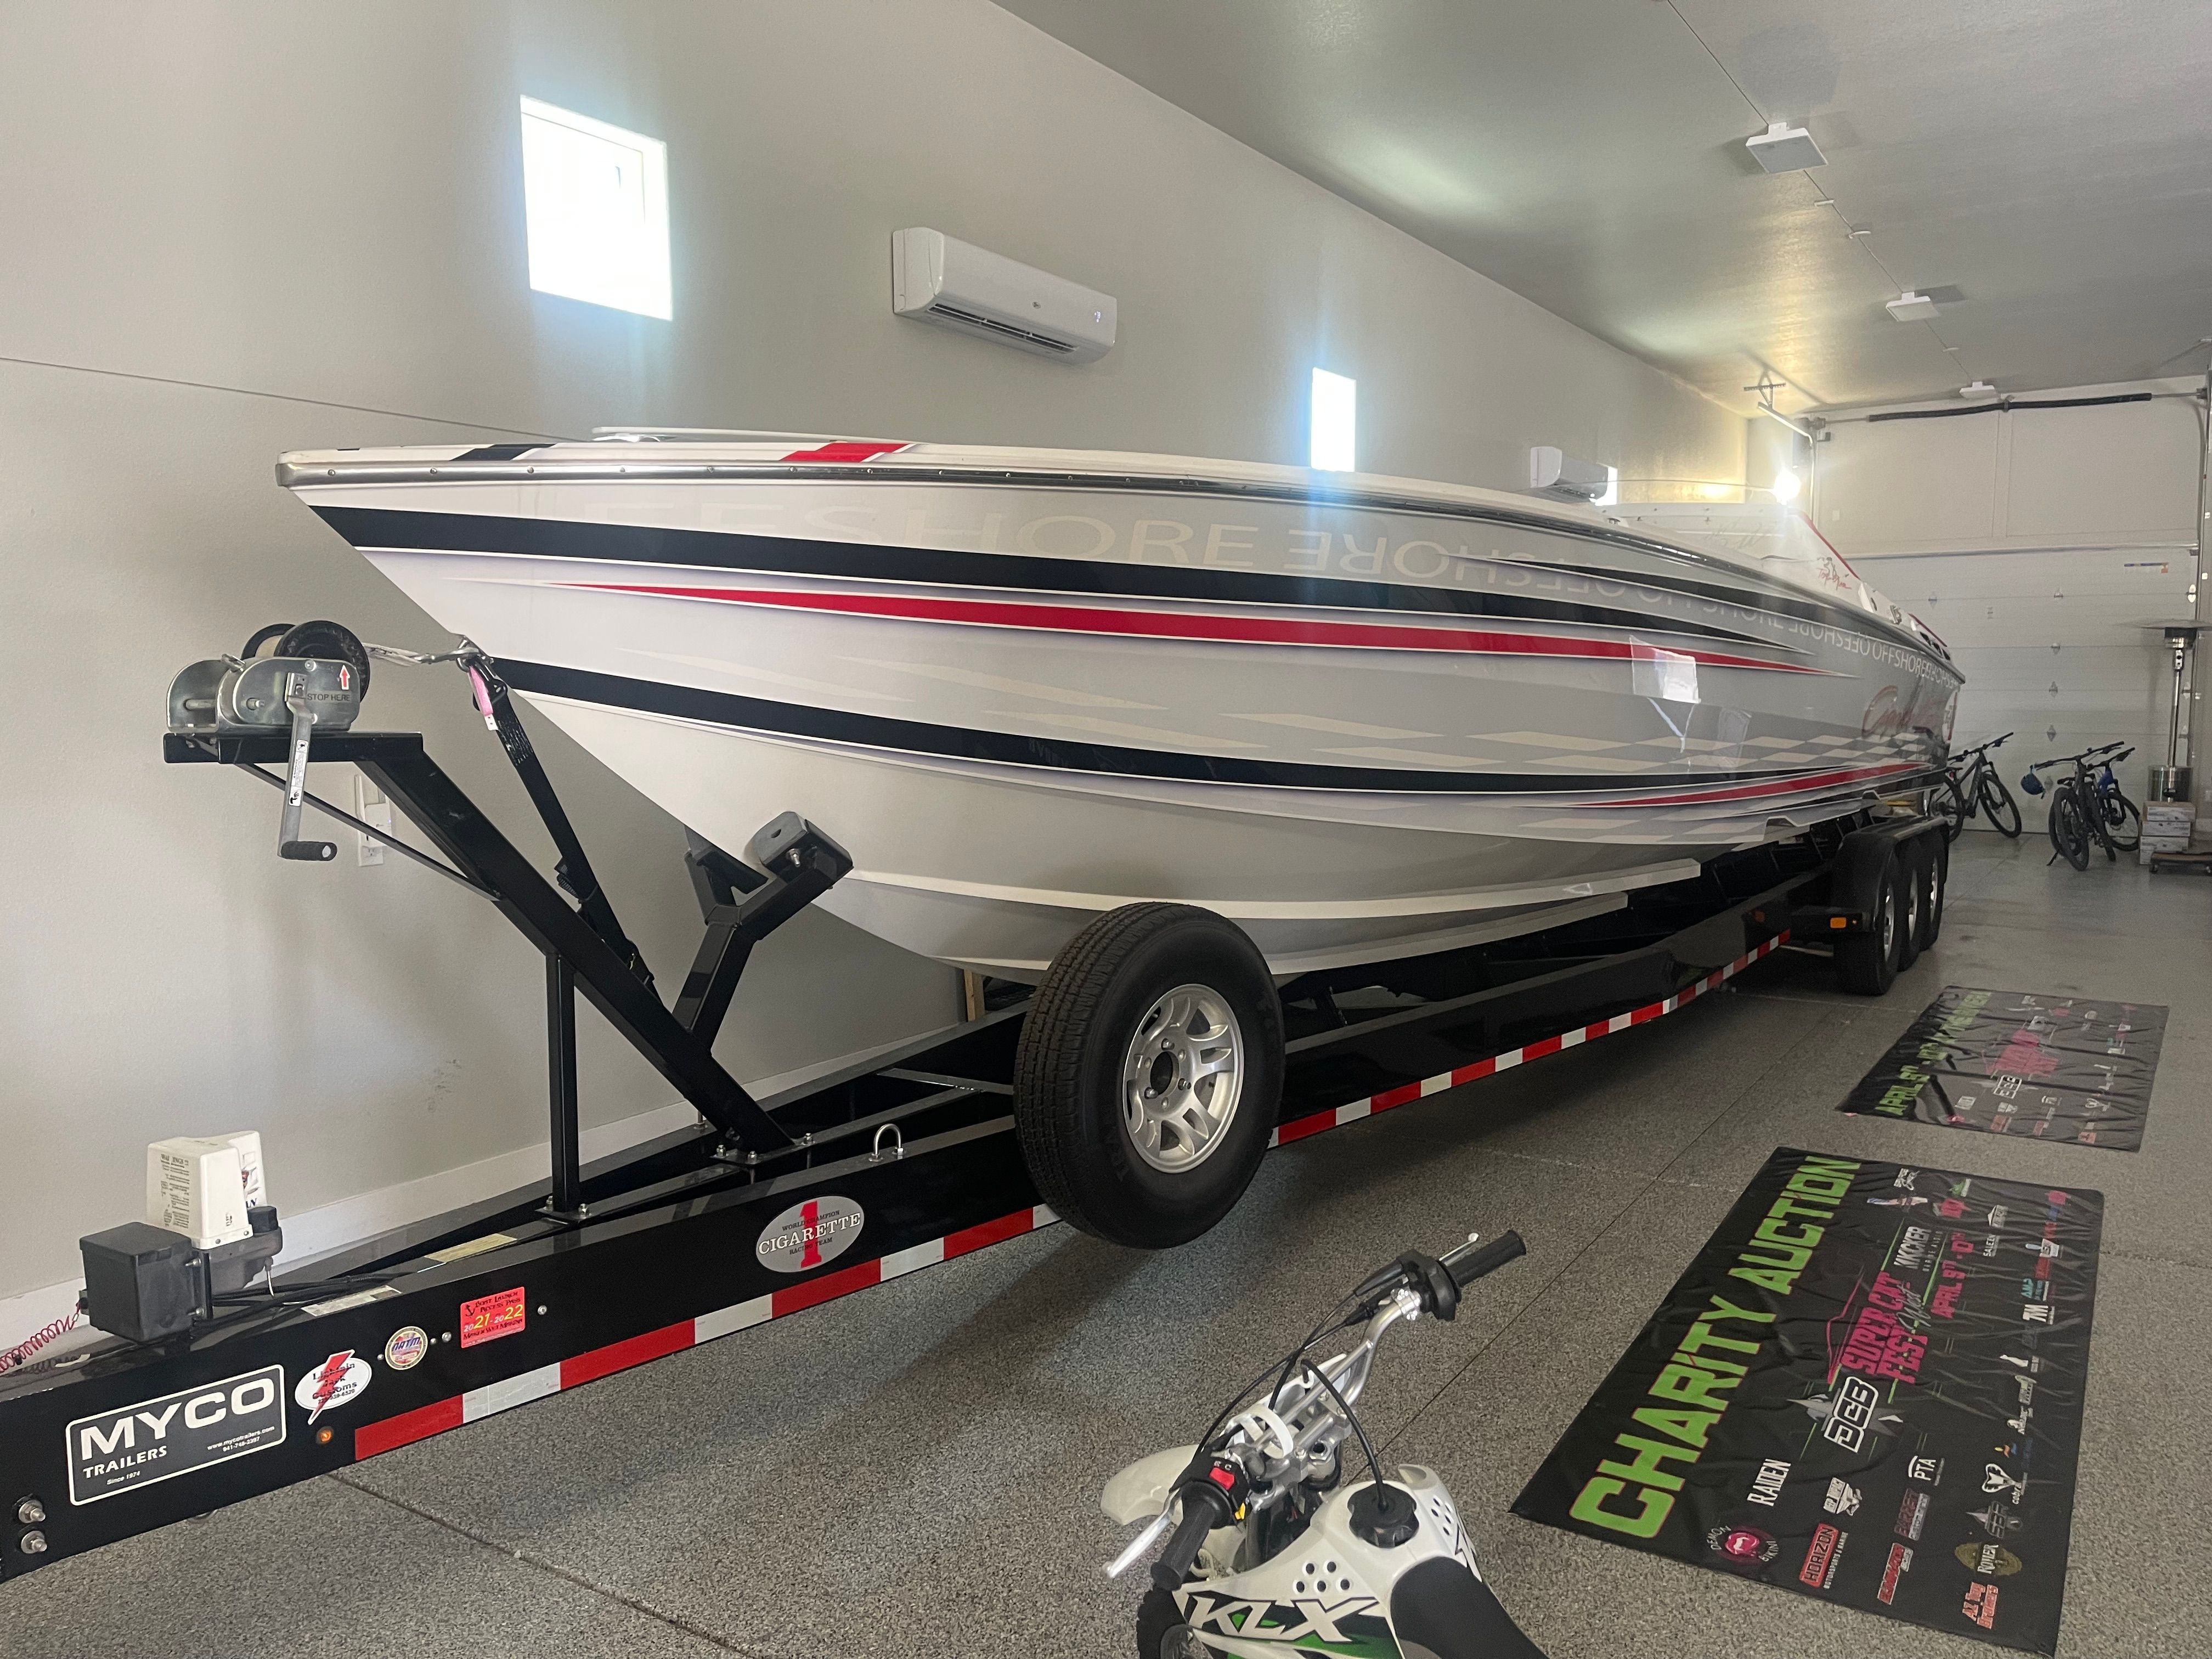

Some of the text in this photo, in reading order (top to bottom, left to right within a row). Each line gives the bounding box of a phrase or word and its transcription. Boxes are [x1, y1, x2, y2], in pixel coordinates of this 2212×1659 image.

[759, 1212, 861, 1255] CIGARETTE
[782, 1210, 839, 1232] WORLD CHAMPION
[789, 1237, 833, 1255] RACING TEAM
[1930, 1281, 1963, 1318] APRIL
[1841, 1272, 1913, 1375] SUPER CAT
[1570, 1155, 1862, 1539] CHARITY AUCTION
[1877, 1324, 1928, 1383] FEST
[80, 1378, 274, 1461] MYCO
[83, 1445, 167, 1479] TRAILERS
[106, 1471, 140, 1485] Since 1974
[1747, 1458, 1791, 1506] RAIDEN
[1913, 1455, 1937, 1481] PTA
[1707, 1525, 1731, 1550] DEMON
[1758, 1540, 1779, 1562] BIKINI
[1804, 1527, 1833, 1582] HORIZON
[1187, 1594, 1380, 1643] KLX
